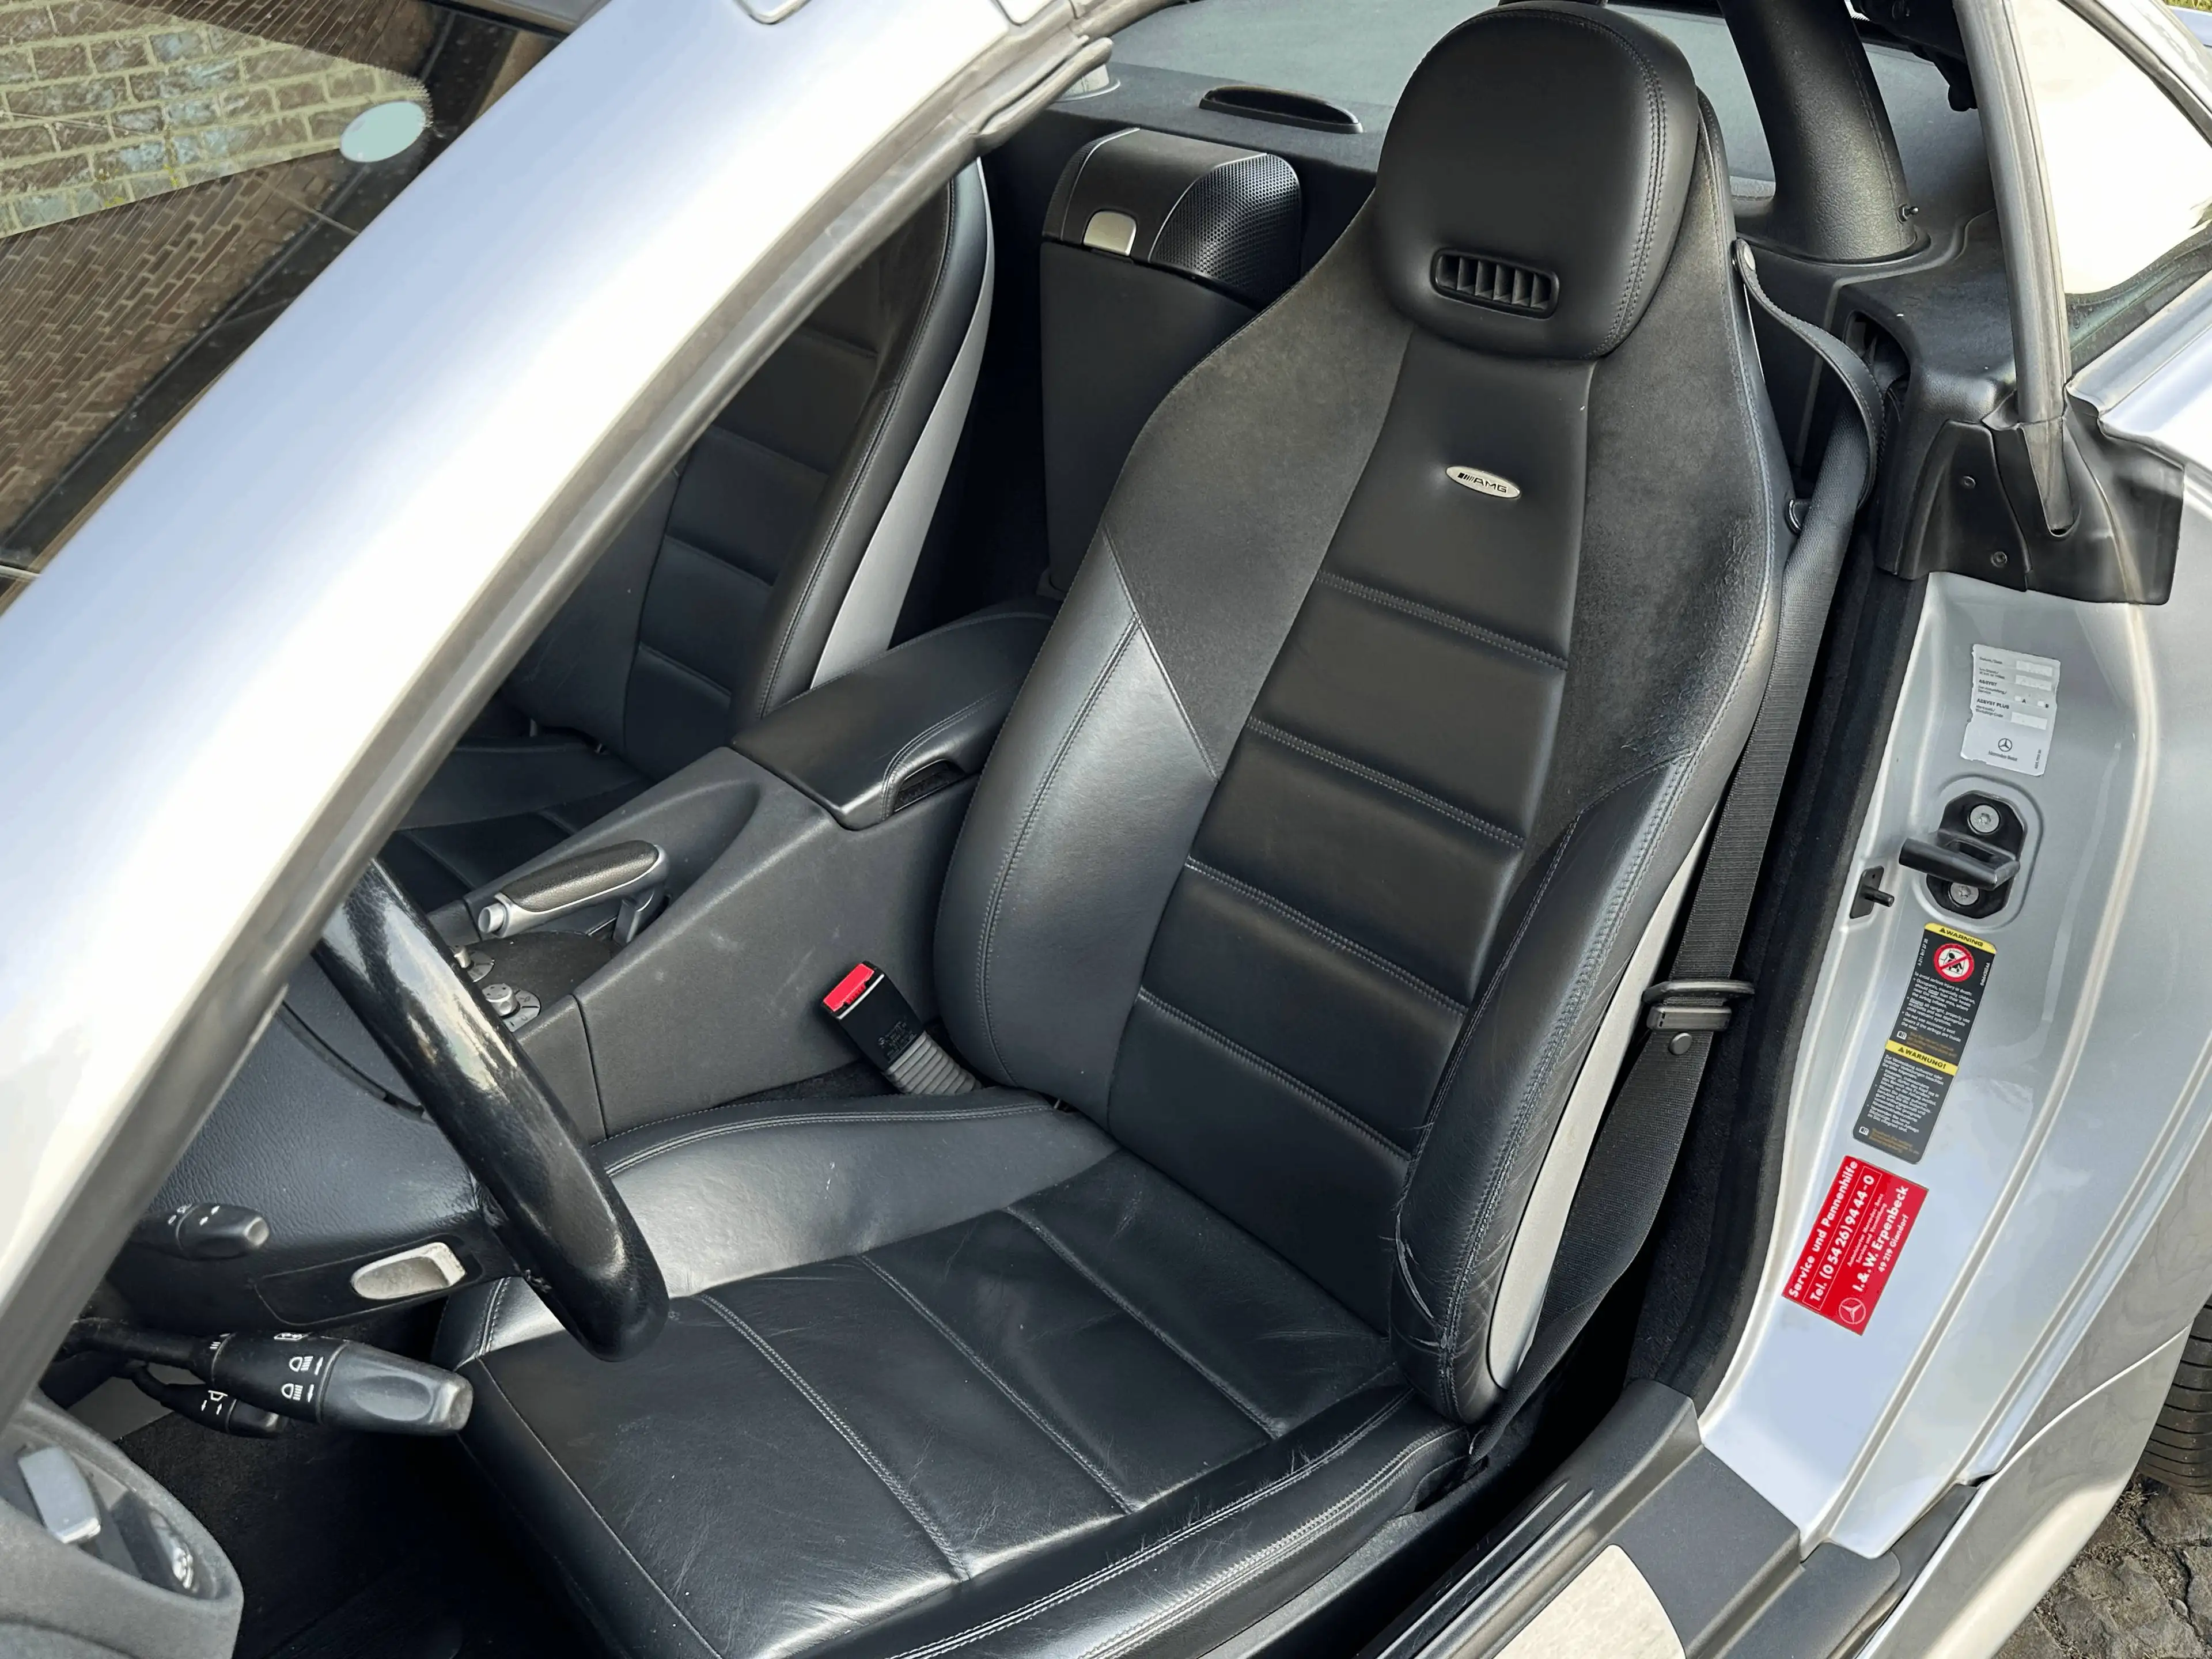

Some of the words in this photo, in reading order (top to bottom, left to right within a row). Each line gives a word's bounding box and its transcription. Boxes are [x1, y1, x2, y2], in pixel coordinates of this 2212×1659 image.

[1473, 478, 1507, 493] AMG
[1946, 930, 1983, 946] WARNING
[1904, 1048, 1946, 1069] WARNUNG!
[1843, 1207, 1861, 1226] 94
[1869, 1183, 1912, 1252] Erpenbeck
[1787, 1253, 1816, 1299] Service
[1809, 1228, 1828, 1252] und
[1820, 1159, 1859, 1228] Pannenhilfe
[1832, 1224, 1854, 1249] 26)
[1827, 1245, 1843, 1264] 54
[1818, 1262, 1836, 1280] (0
[1809, 1279, 1827, 1302] Tel.
